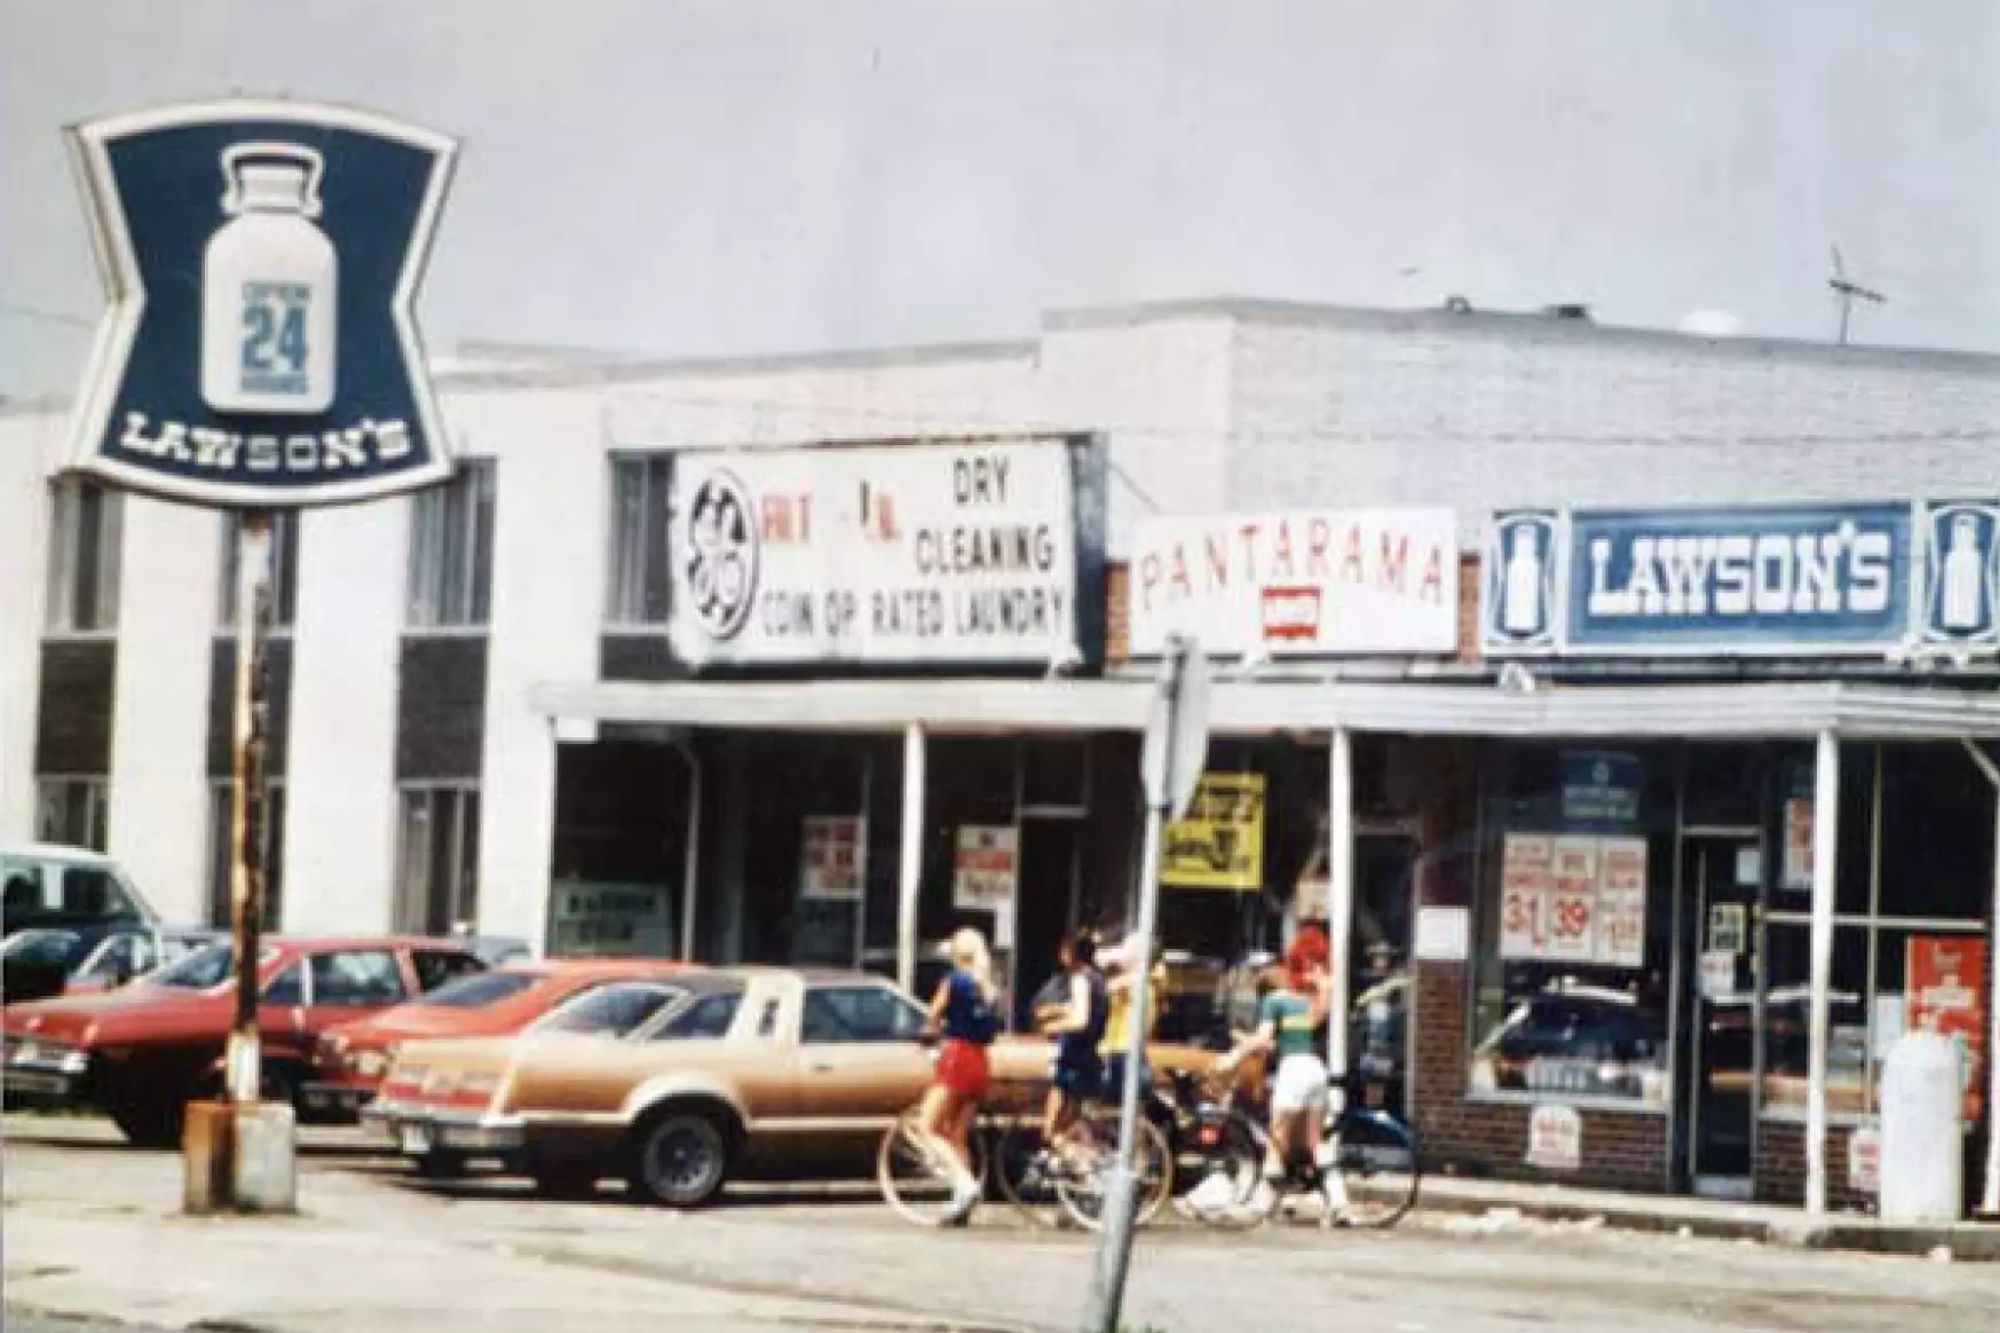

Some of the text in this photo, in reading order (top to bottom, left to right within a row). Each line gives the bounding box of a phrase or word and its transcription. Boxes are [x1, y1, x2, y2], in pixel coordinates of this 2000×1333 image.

[241, 305, 306, 370] 24
[119, 410, 412, 471] LAWSON'S
[951, 455, 1009, 505] DRY
[915, 524, 1055, 574] CLEANING
[1141, 516, 1443, 611] PANTARAMA
[1587, 518, 1892, 617] LAWSON'S
[763, 587, 814, 637] COIN
[954, 584, 1064, 638] LAUNDRY
